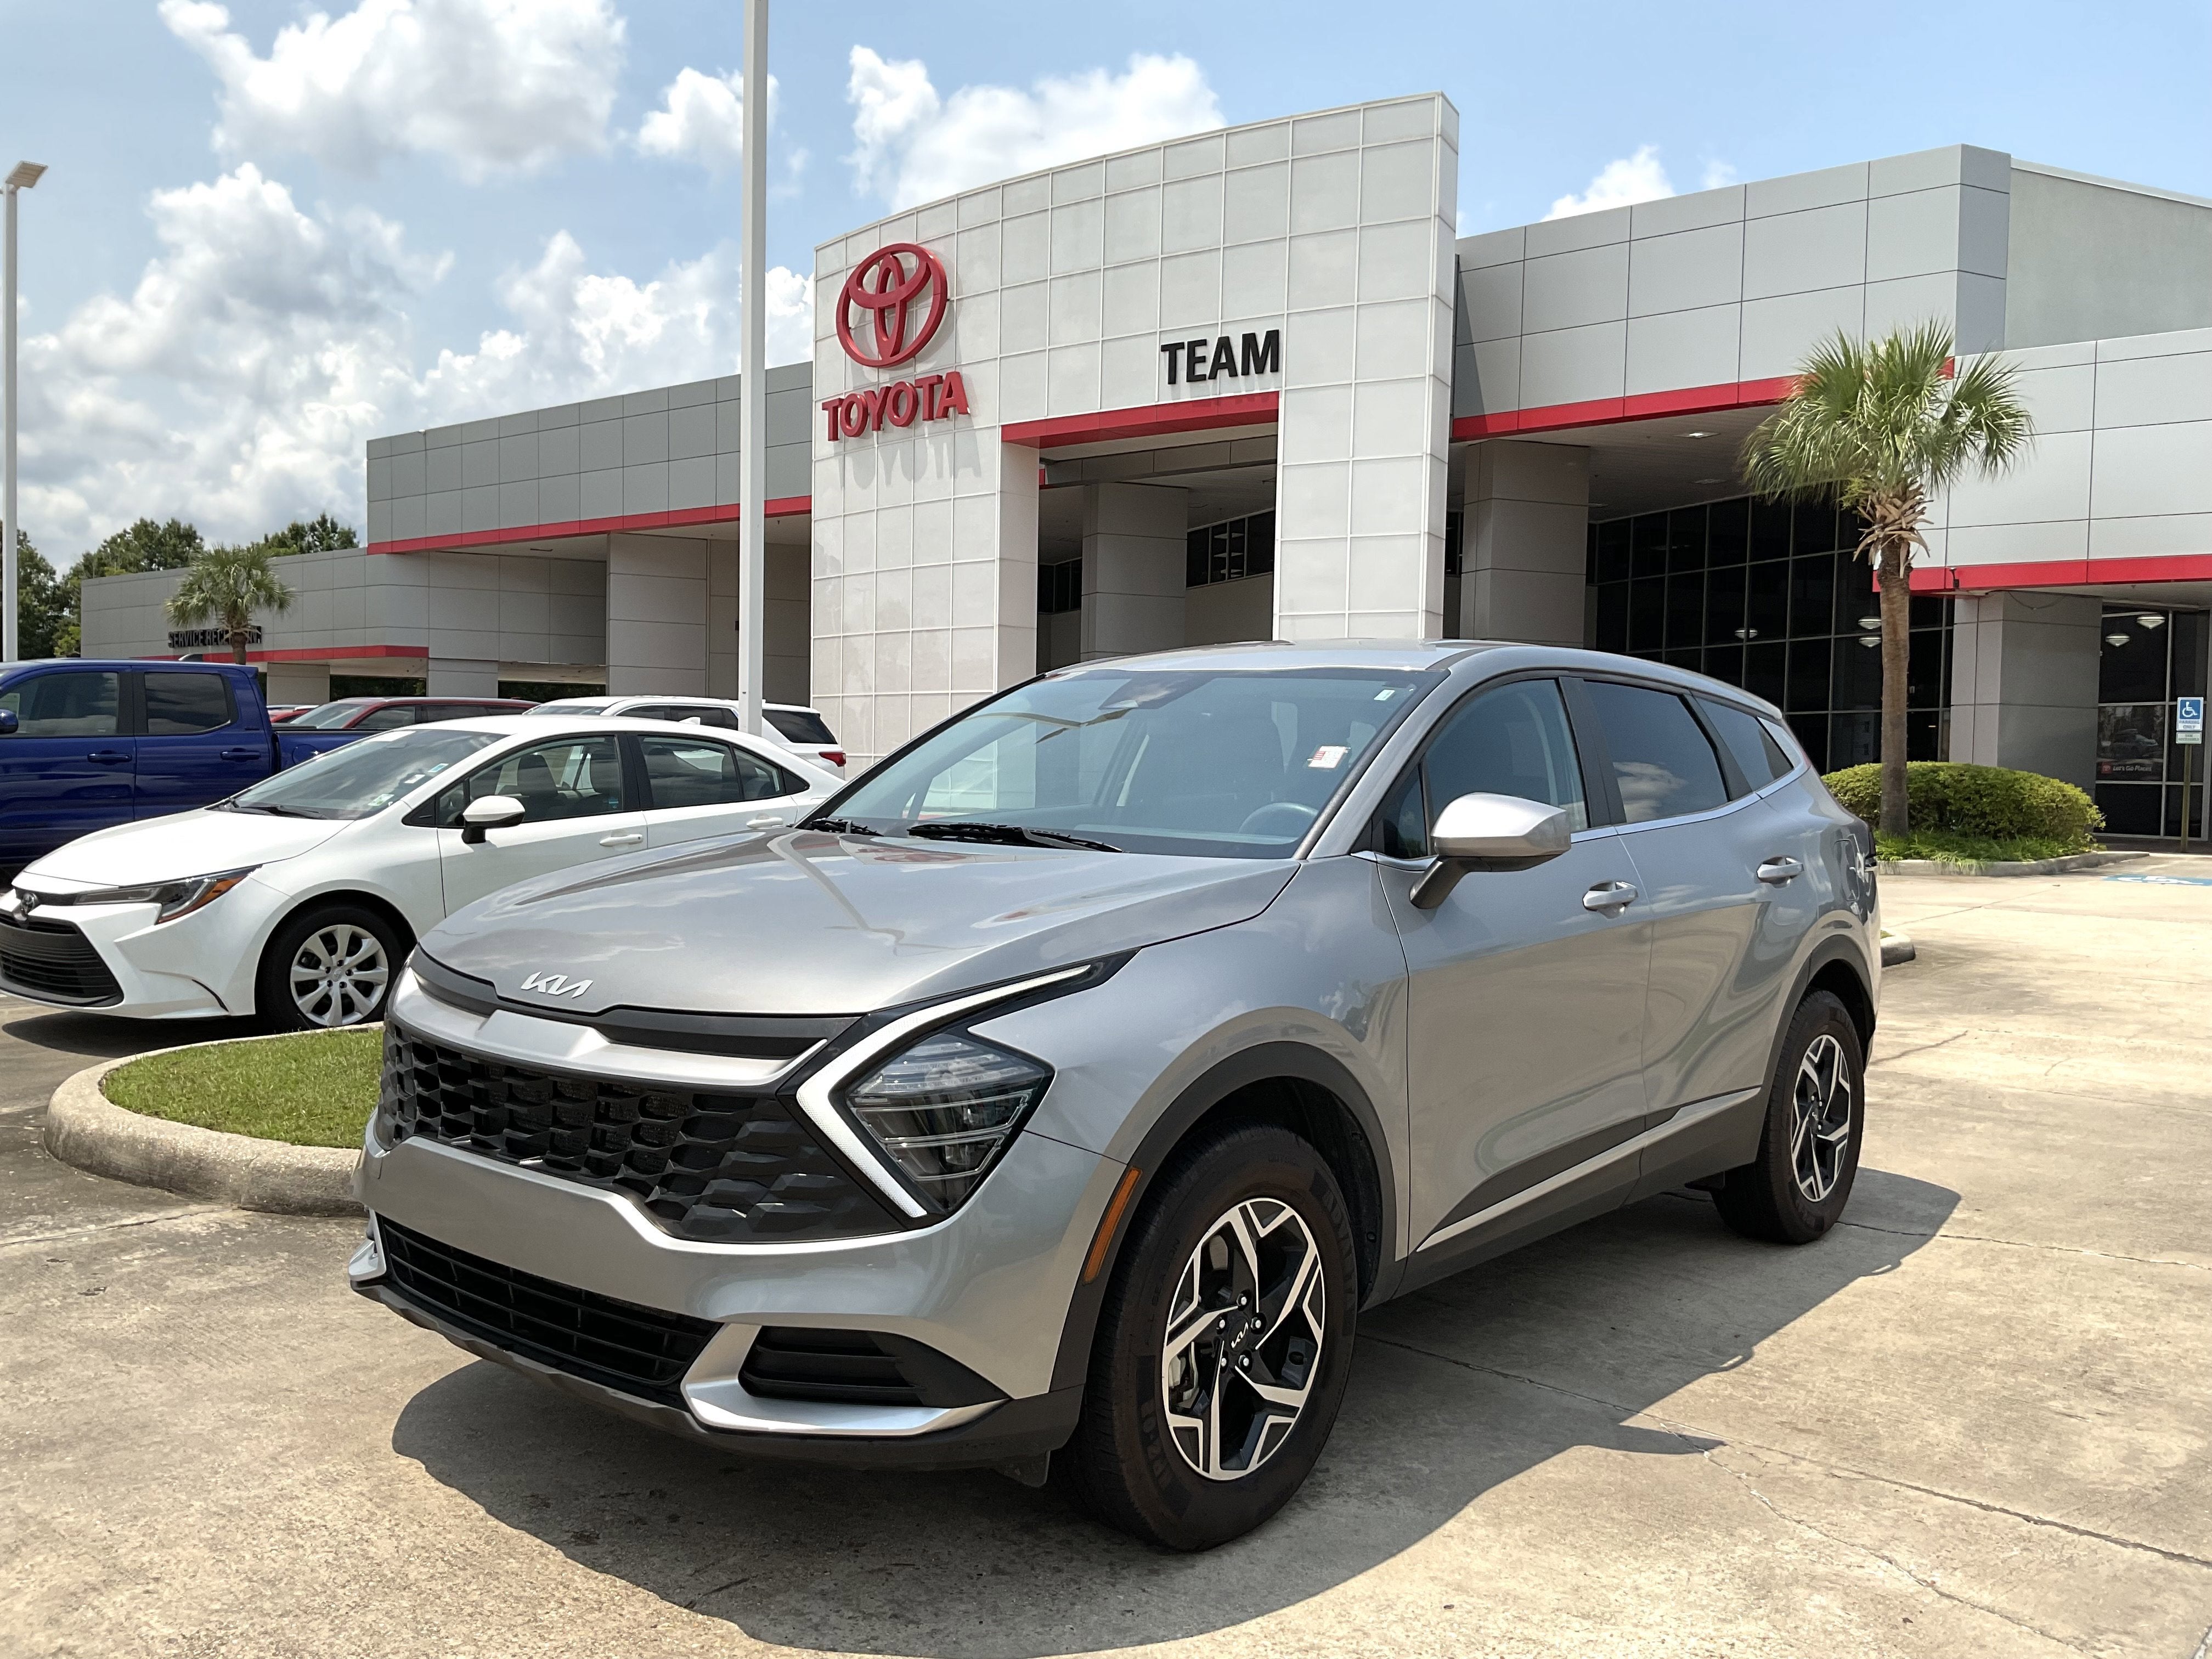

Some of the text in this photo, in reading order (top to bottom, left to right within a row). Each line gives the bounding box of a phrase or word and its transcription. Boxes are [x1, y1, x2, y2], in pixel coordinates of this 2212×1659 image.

[1160, 329, 1279, 384] TEAM
[822, 371, 970, 441] TOYOTA
[168, 630, 206, 648] SERVICE
[521, 971, 594, 998] KIA
[1231, 1322, 1249, 1346] KIA
